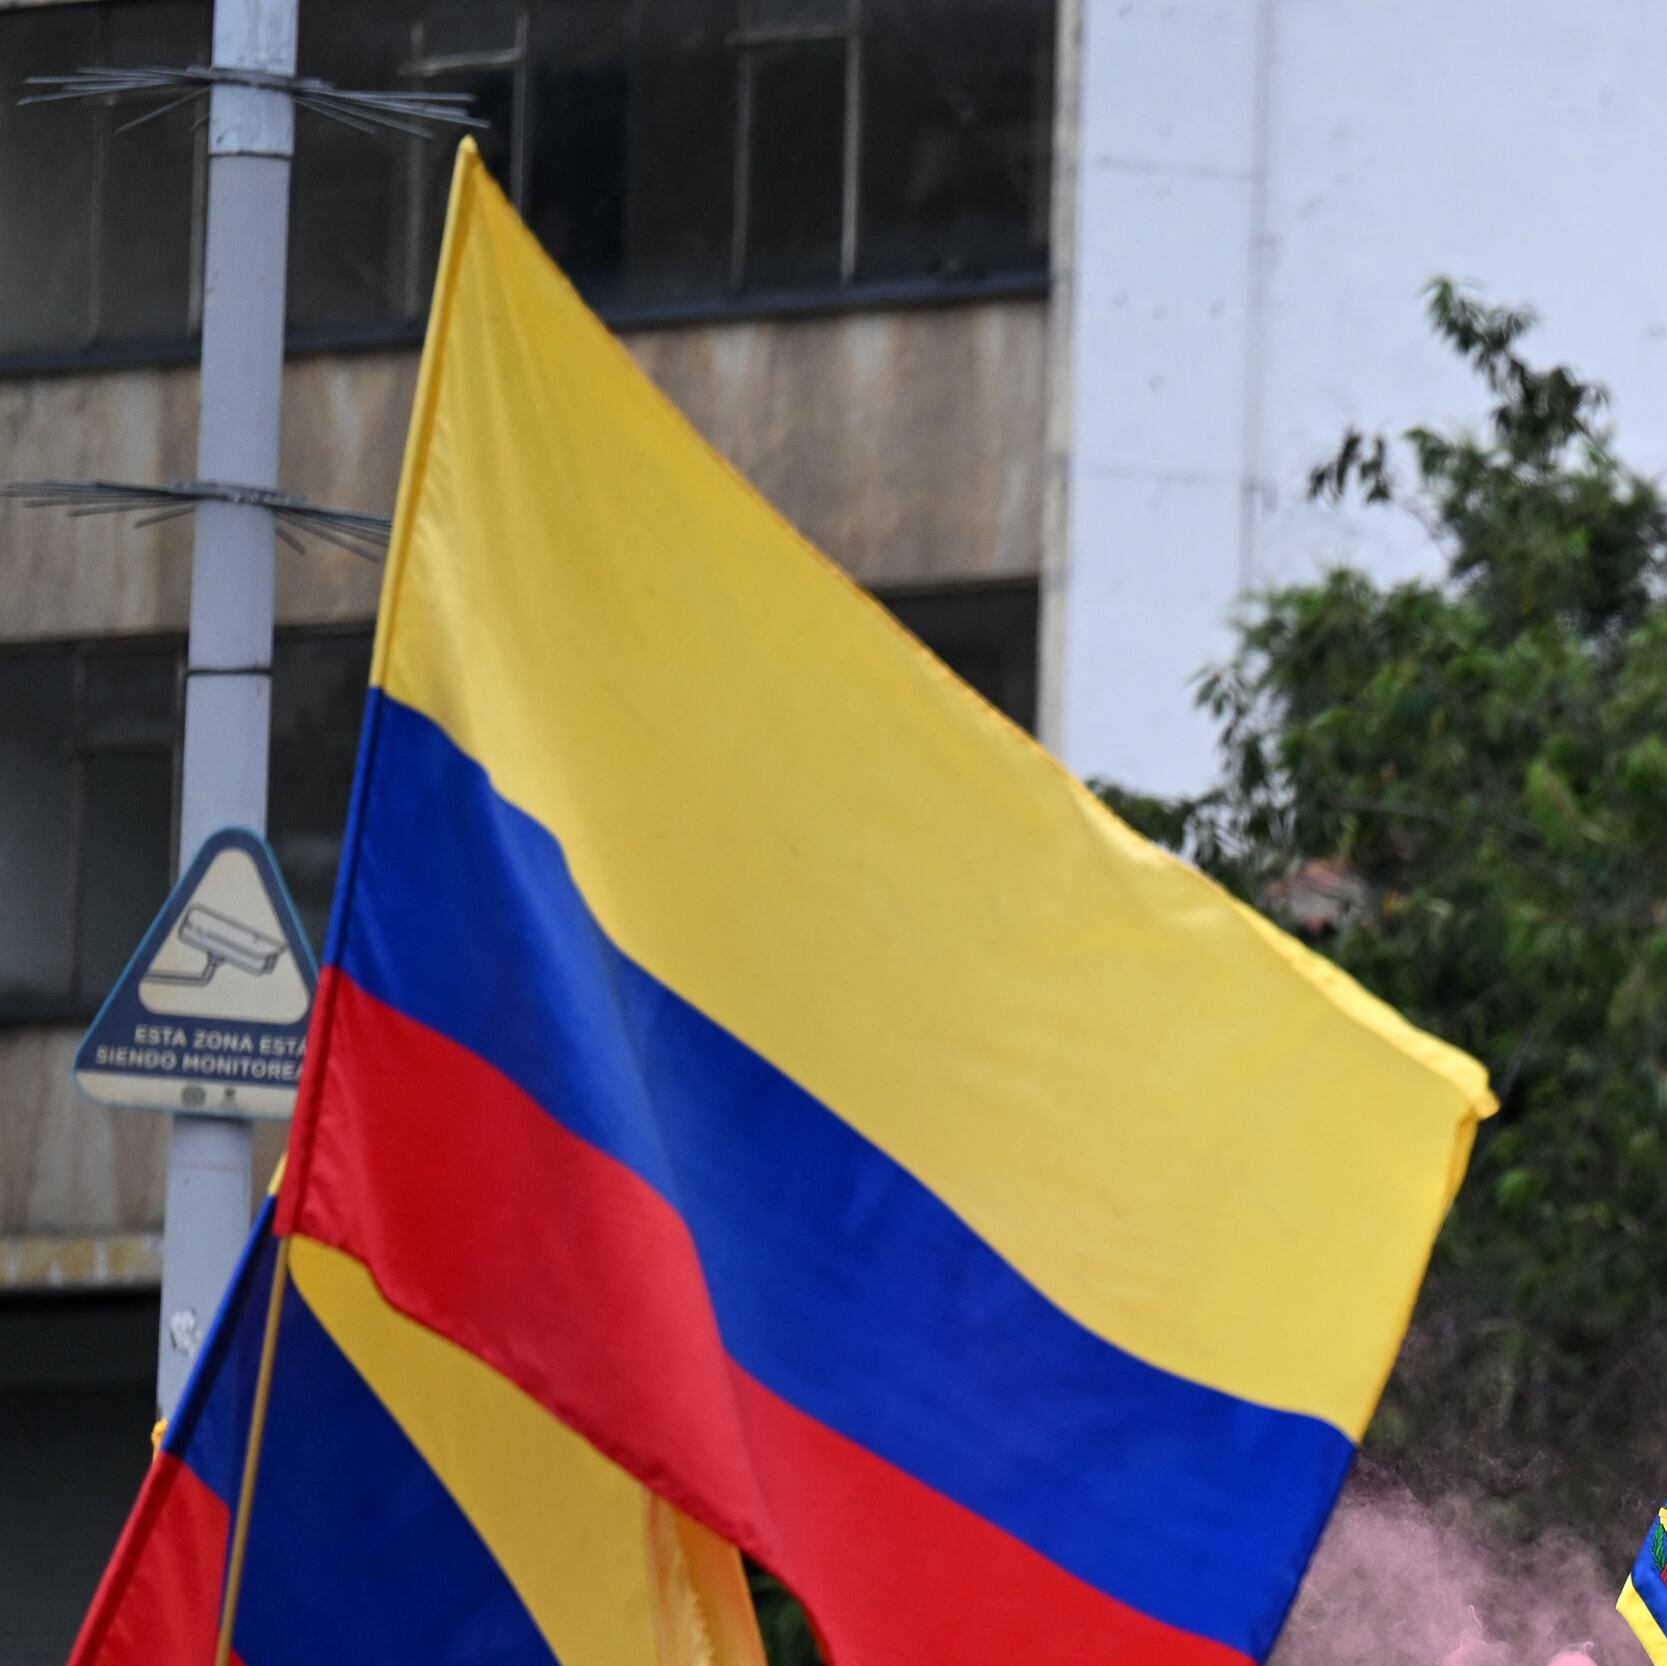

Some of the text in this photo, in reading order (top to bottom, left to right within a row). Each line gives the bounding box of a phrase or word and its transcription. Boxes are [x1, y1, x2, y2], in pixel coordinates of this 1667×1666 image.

[134, 1024, 187, 1048] ESTA
[192, 1028, 254, 1053] ZONA
[96, 1045, 178, 1070] SIENDO
